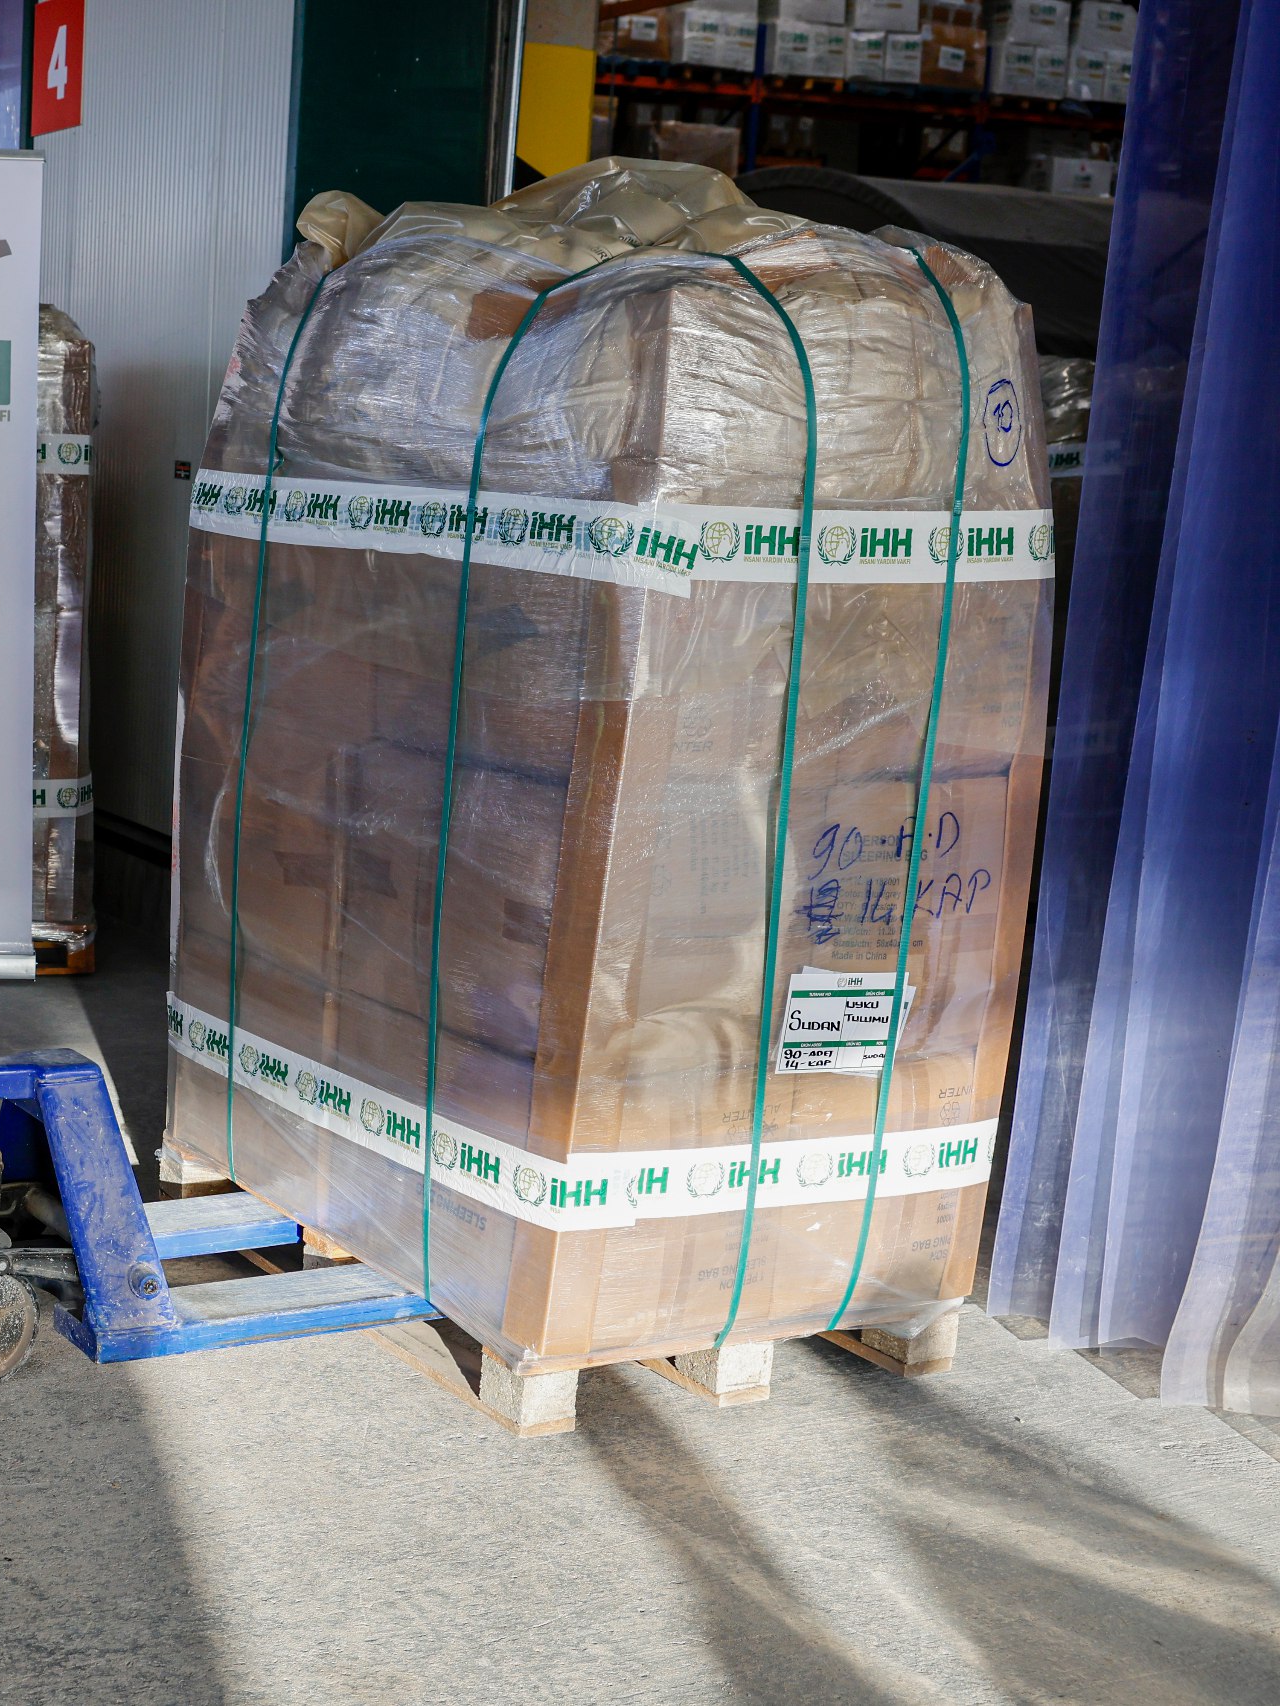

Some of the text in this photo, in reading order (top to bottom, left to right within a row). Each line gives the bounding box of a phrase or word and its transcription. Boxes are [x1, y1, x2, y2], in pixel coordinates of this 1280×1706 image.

[47, 24, 68, 100] 4
[832, 951, 854, 960] Made
[865, 951, 887, 960] China
